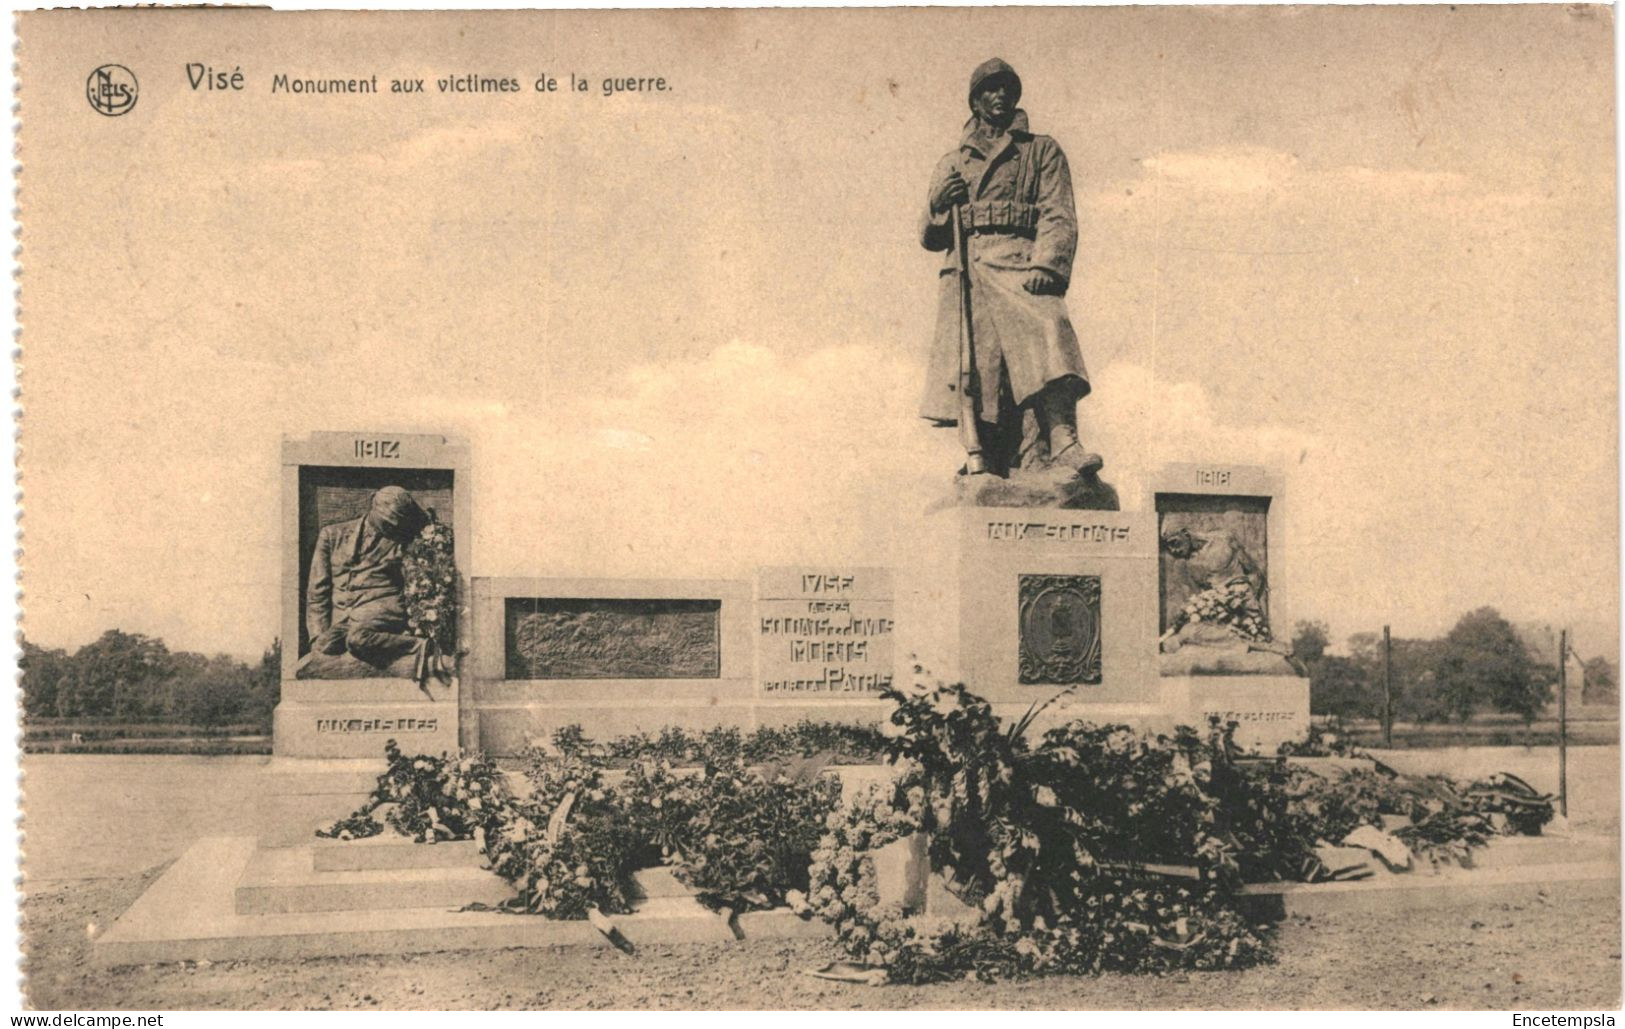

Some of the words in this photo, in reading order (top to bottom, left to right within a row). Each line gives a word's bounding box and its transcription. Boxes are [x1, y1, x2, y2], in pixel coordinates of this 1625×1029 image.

[186, 63, 244, 91] Visé
[271, 74, 378, 94] Monument
[390, 78, 424, 93] aux
[437, 74, 520, 92] victimes
[535, 73, 558, 92] de
[570, 73, 589, 92] la
[602, 76, 673, 97] guerre.
[354, 440, 401, 459] 1914
[1196, 470, 1231, 487] 1918
[988, 523, 1026, 540] AUX
[1046, 524, 1130, 543] SOLDATS
[761, 617, 830, 636] SOLDATS
[790, 640, 868, 663] MORTS
[764, 679, 797, 692] POUR
[316, 719, 349, 733] AUX
